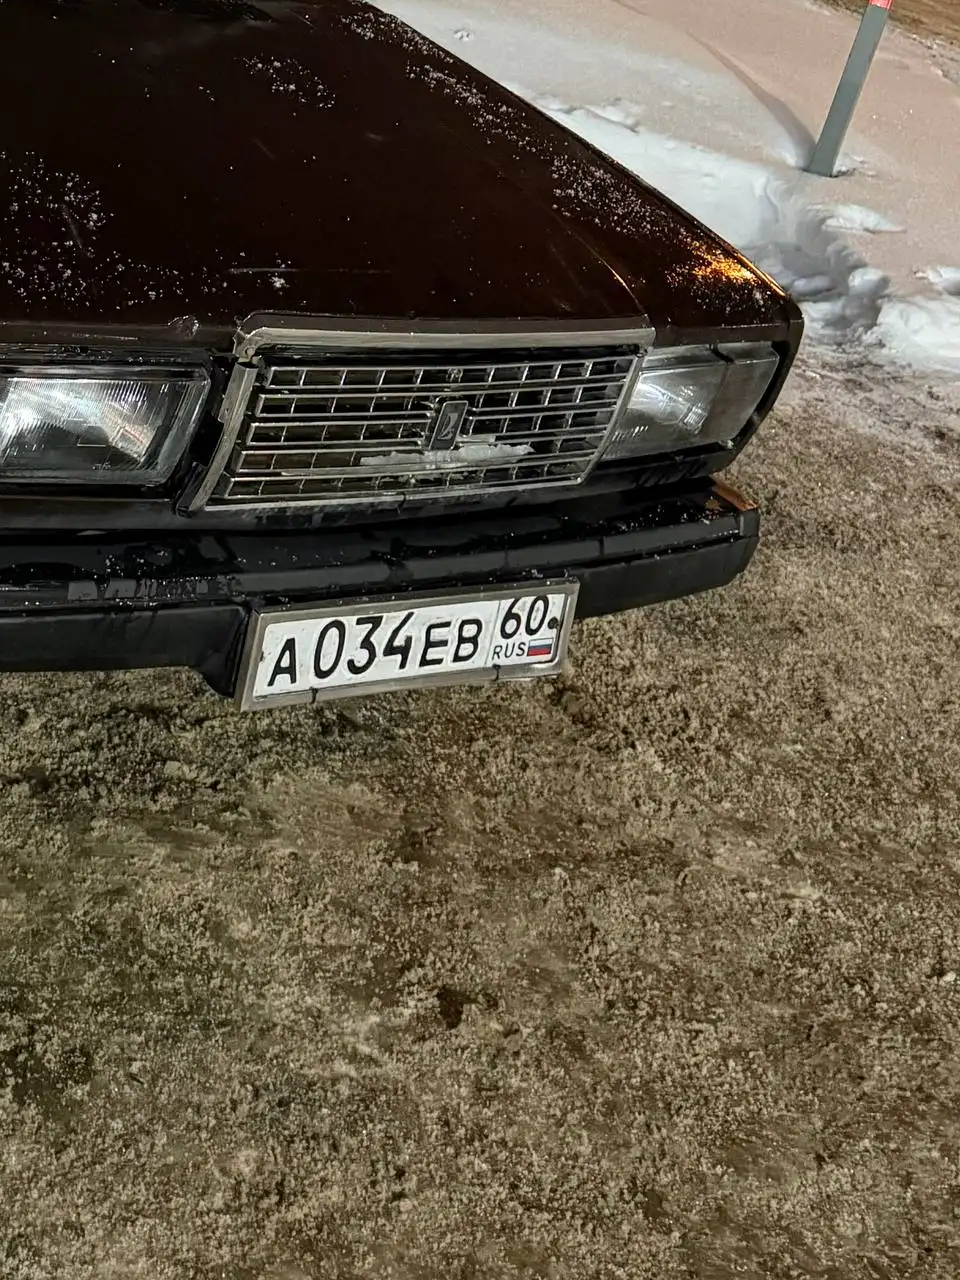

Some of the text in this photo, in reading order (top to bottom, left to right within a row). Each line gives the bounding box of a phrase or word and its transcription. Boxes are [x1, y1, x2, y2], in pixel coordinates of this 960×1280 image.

[267, 594, 550, 687] А034ЕВ 60
[492, 642, 526, 660] RUS
